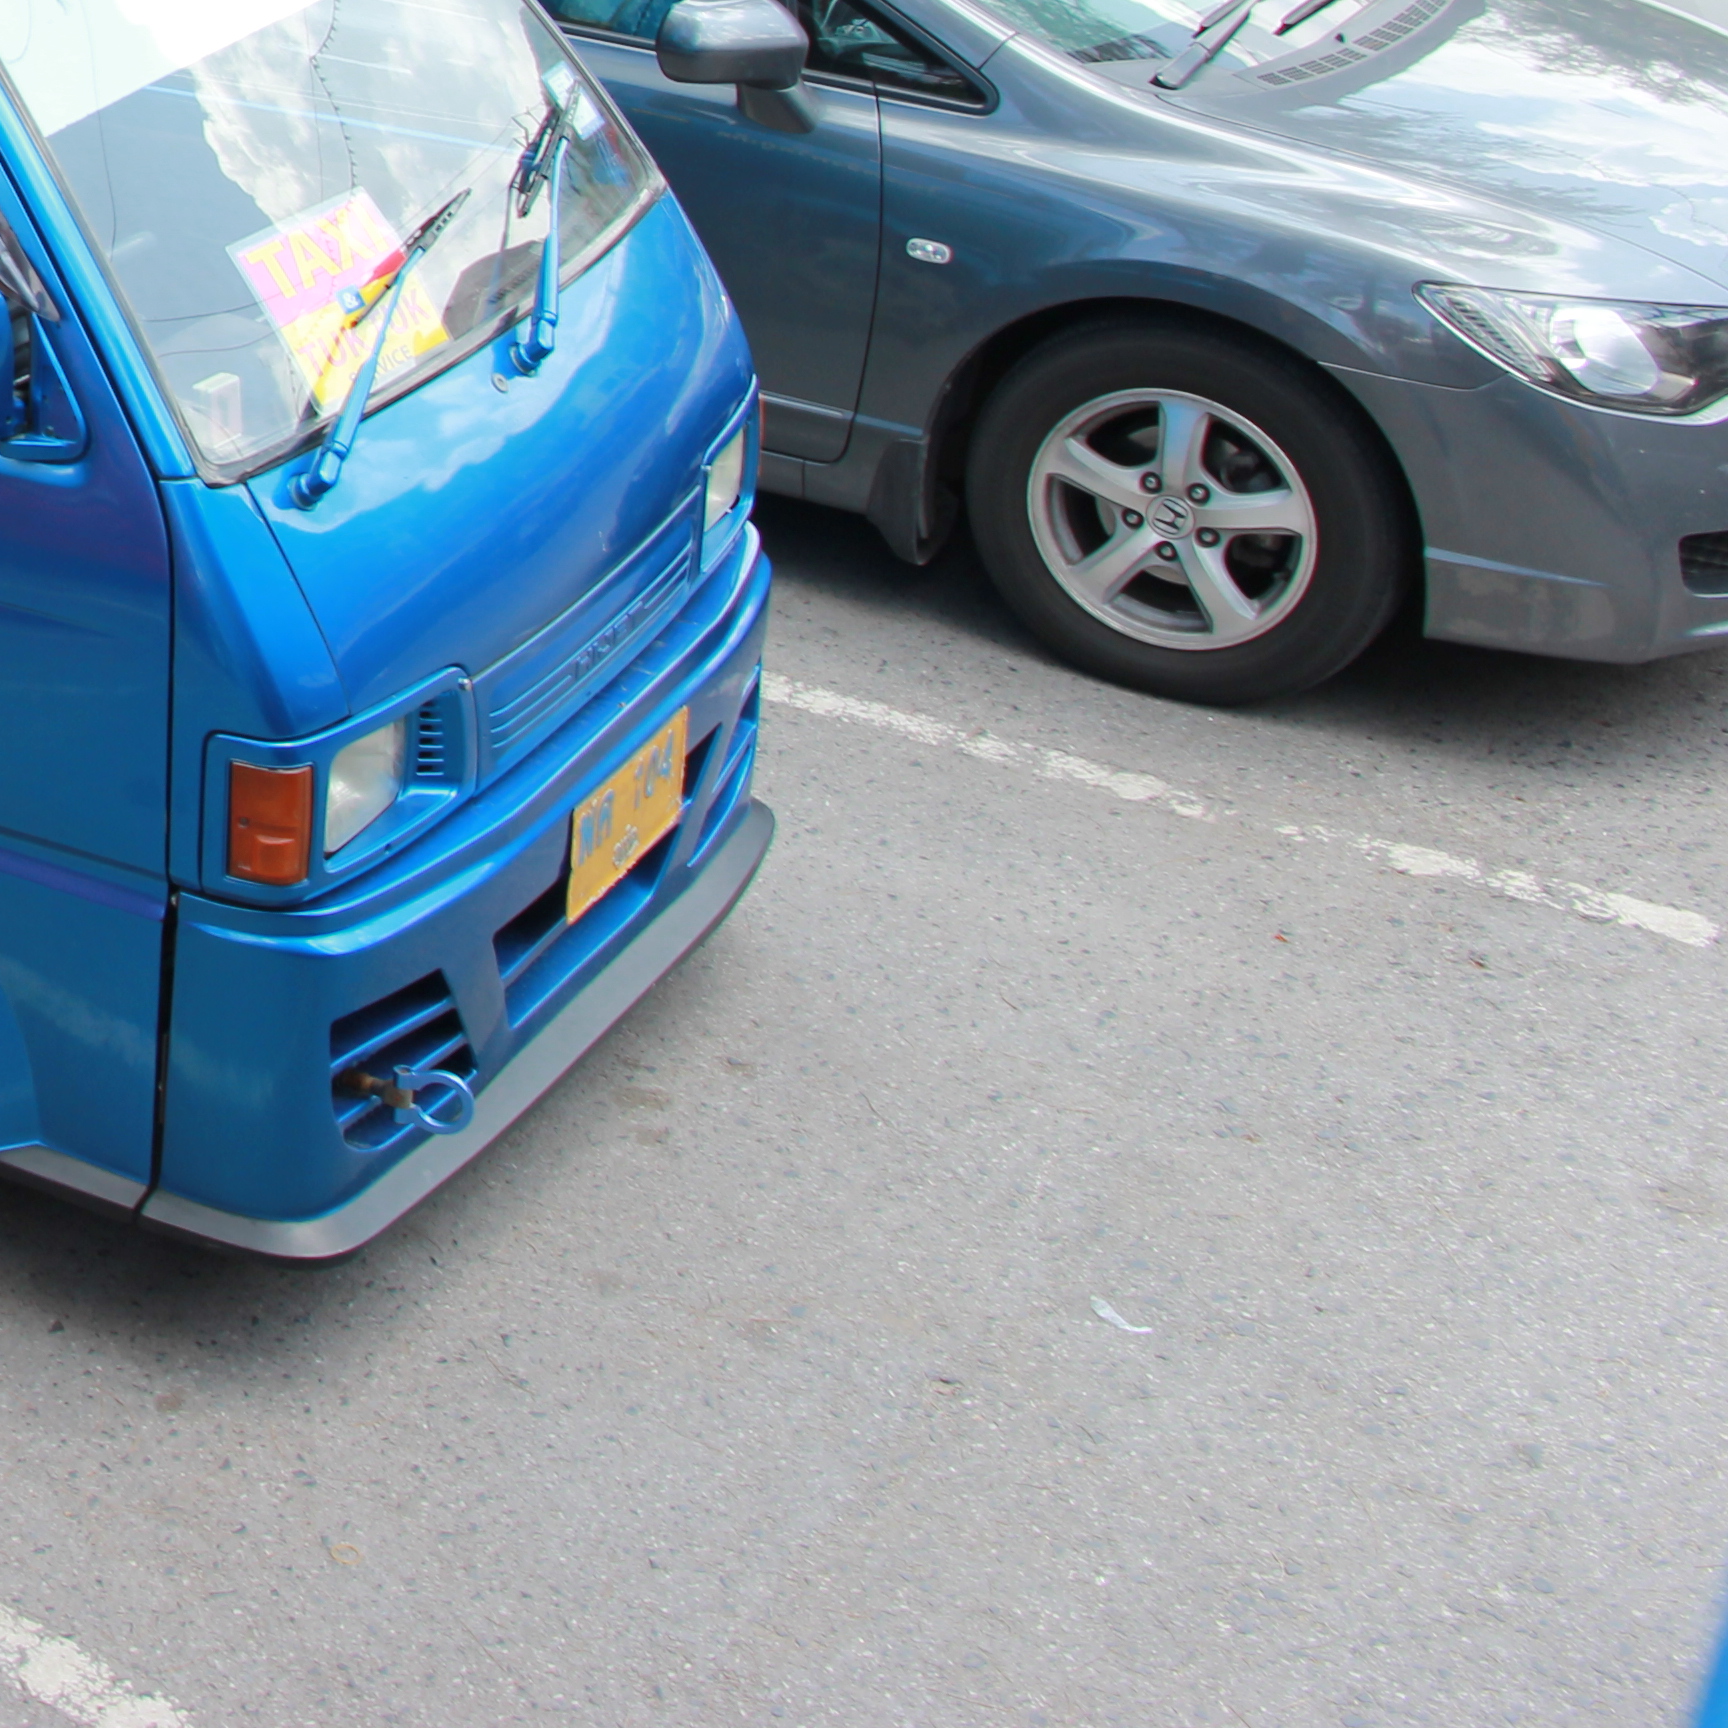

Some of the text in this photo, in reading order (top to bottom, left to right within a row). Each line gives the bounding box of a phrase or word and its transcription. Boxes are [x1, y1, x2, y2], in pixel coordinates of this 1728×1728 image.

[245, 199, 390, 299] TAXI
[343, 292, 360, 309] &
[298, 325, 370, 377] TUK
